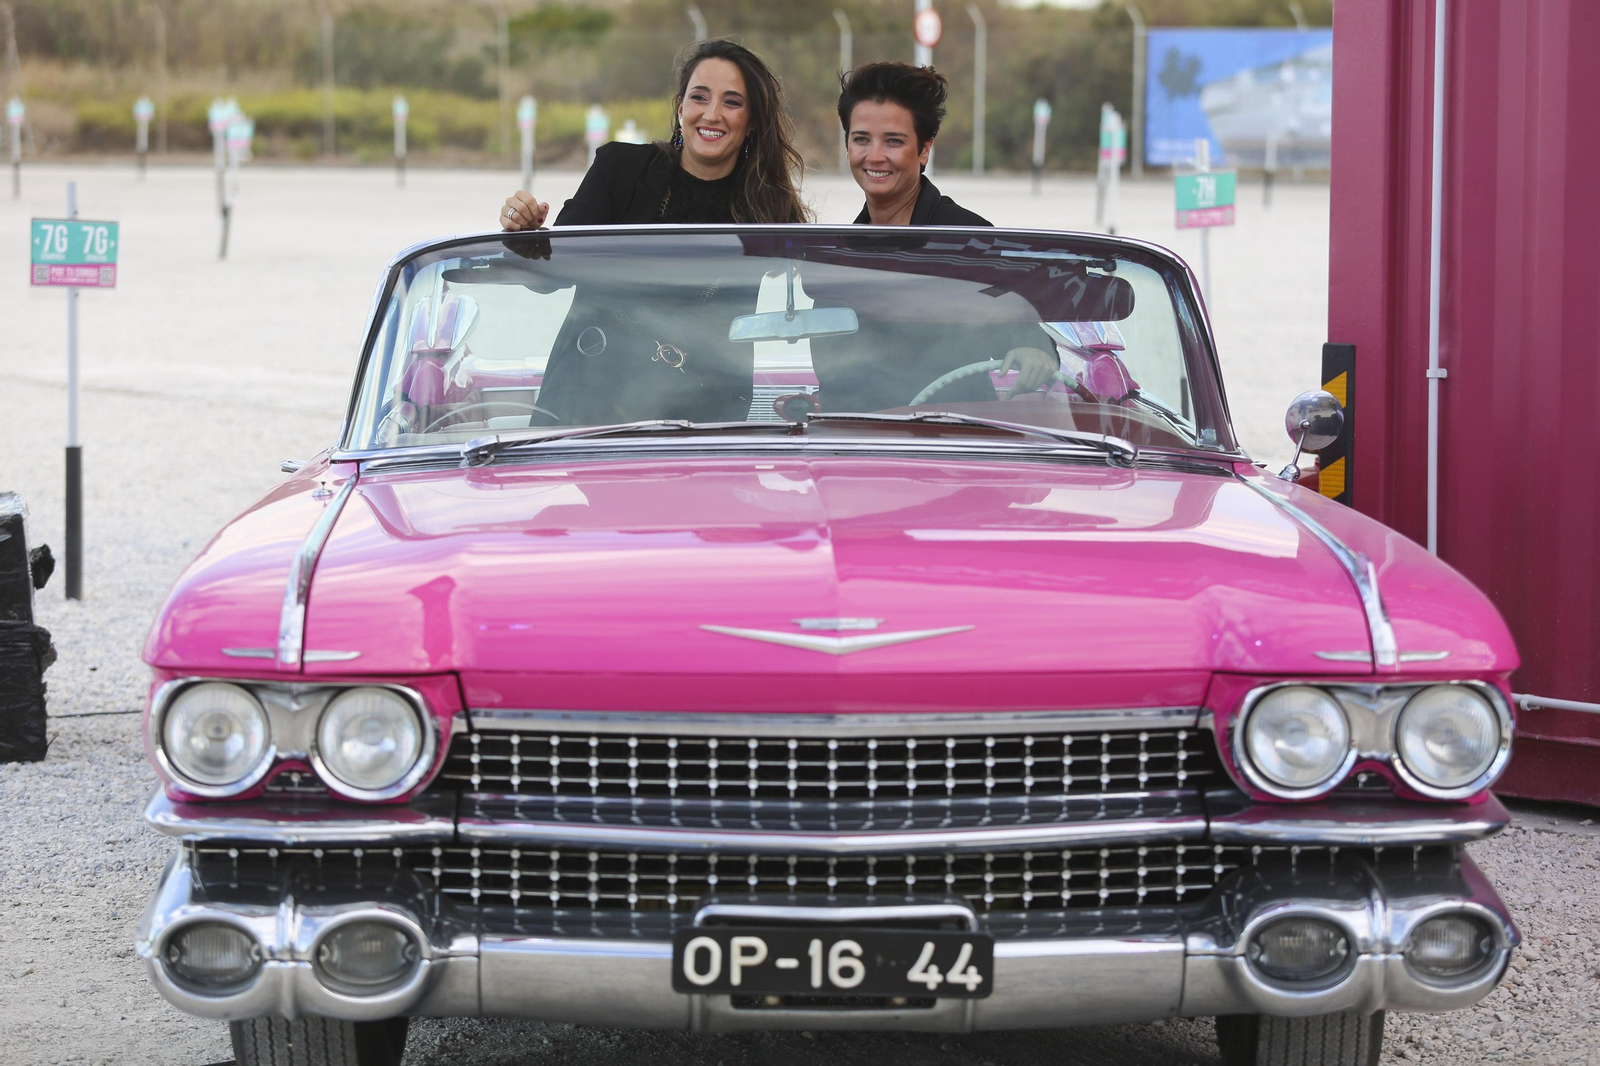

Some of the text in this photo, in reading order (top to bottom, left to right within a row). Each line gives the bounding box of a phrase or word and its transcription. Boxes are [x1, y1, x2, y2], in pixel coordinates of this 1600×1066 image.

[41, 224, 109, 255] 7G 7G
[906, 941, 983, 991] 44
